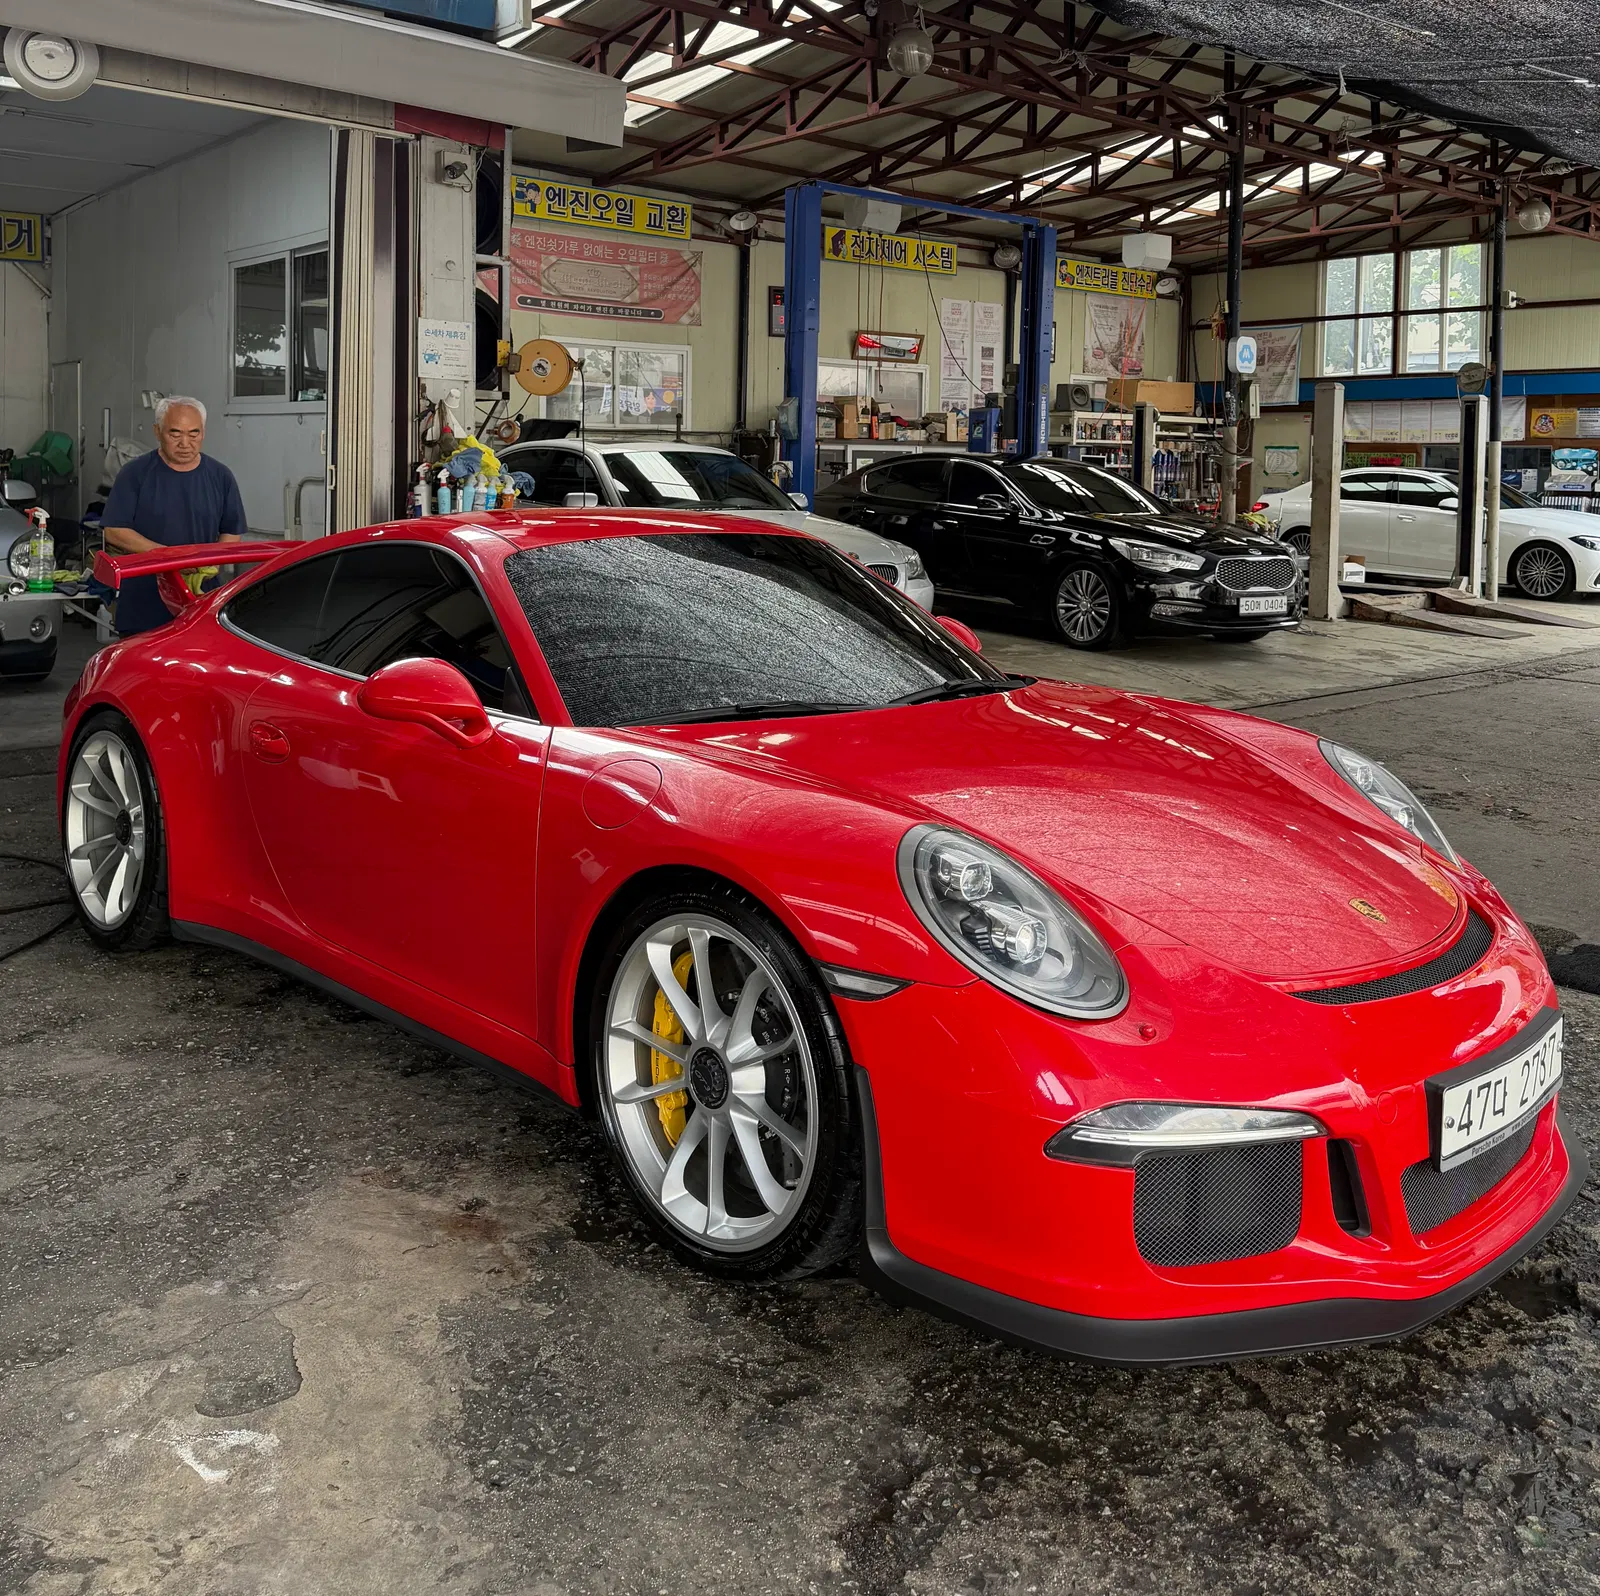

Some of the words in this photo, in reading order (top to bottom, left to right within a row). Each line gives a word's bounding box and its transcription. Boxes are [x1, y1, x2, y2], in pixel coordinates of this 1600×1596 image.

[545, 186, 635, 227] 엔진오일
[645, 202, 688, 234] 교환
[0, 216, 35, 255] 거
[524, 235, 578, 255] 엔진쇳가루
[583, 243, 614, 260] 없애는
[617, 248, 657, 265] 오일필터
[850, 234, 907, 264] 전자제어
[913, 243, 953, 270] 시스템
[1075, 264, 1119, 291] 엔진트러블
[1121, 271, 1154, 297] 진단수리
[1457, 1076, 1508, 1136] 47다
[1519, 1032, 1557, 1108] 2787
